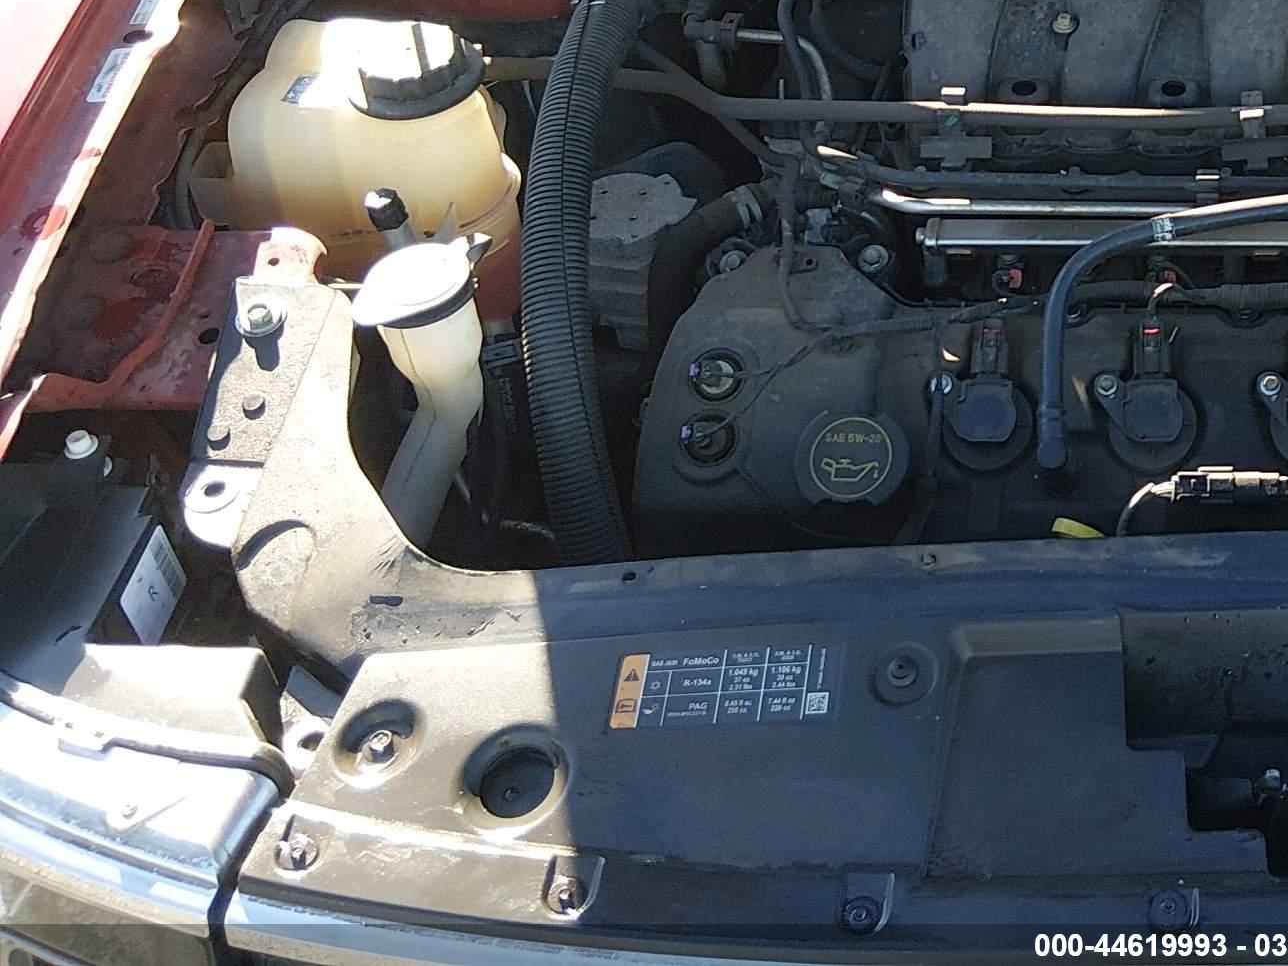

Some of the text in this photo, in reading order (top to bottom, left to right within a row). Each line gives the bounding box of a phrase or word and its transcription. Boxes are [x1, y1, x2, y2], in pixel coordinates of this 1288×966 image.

[825, 433, 882, 443] SAE 5W-20
[683, 656, 720, 666] FoMoCo
[749, 667, 759, 676] kg
[771, 665, 802, 674] 1.106 kg
[683, 678, 712, 687] R-134a
[688, 702, 708, 710] PAG
